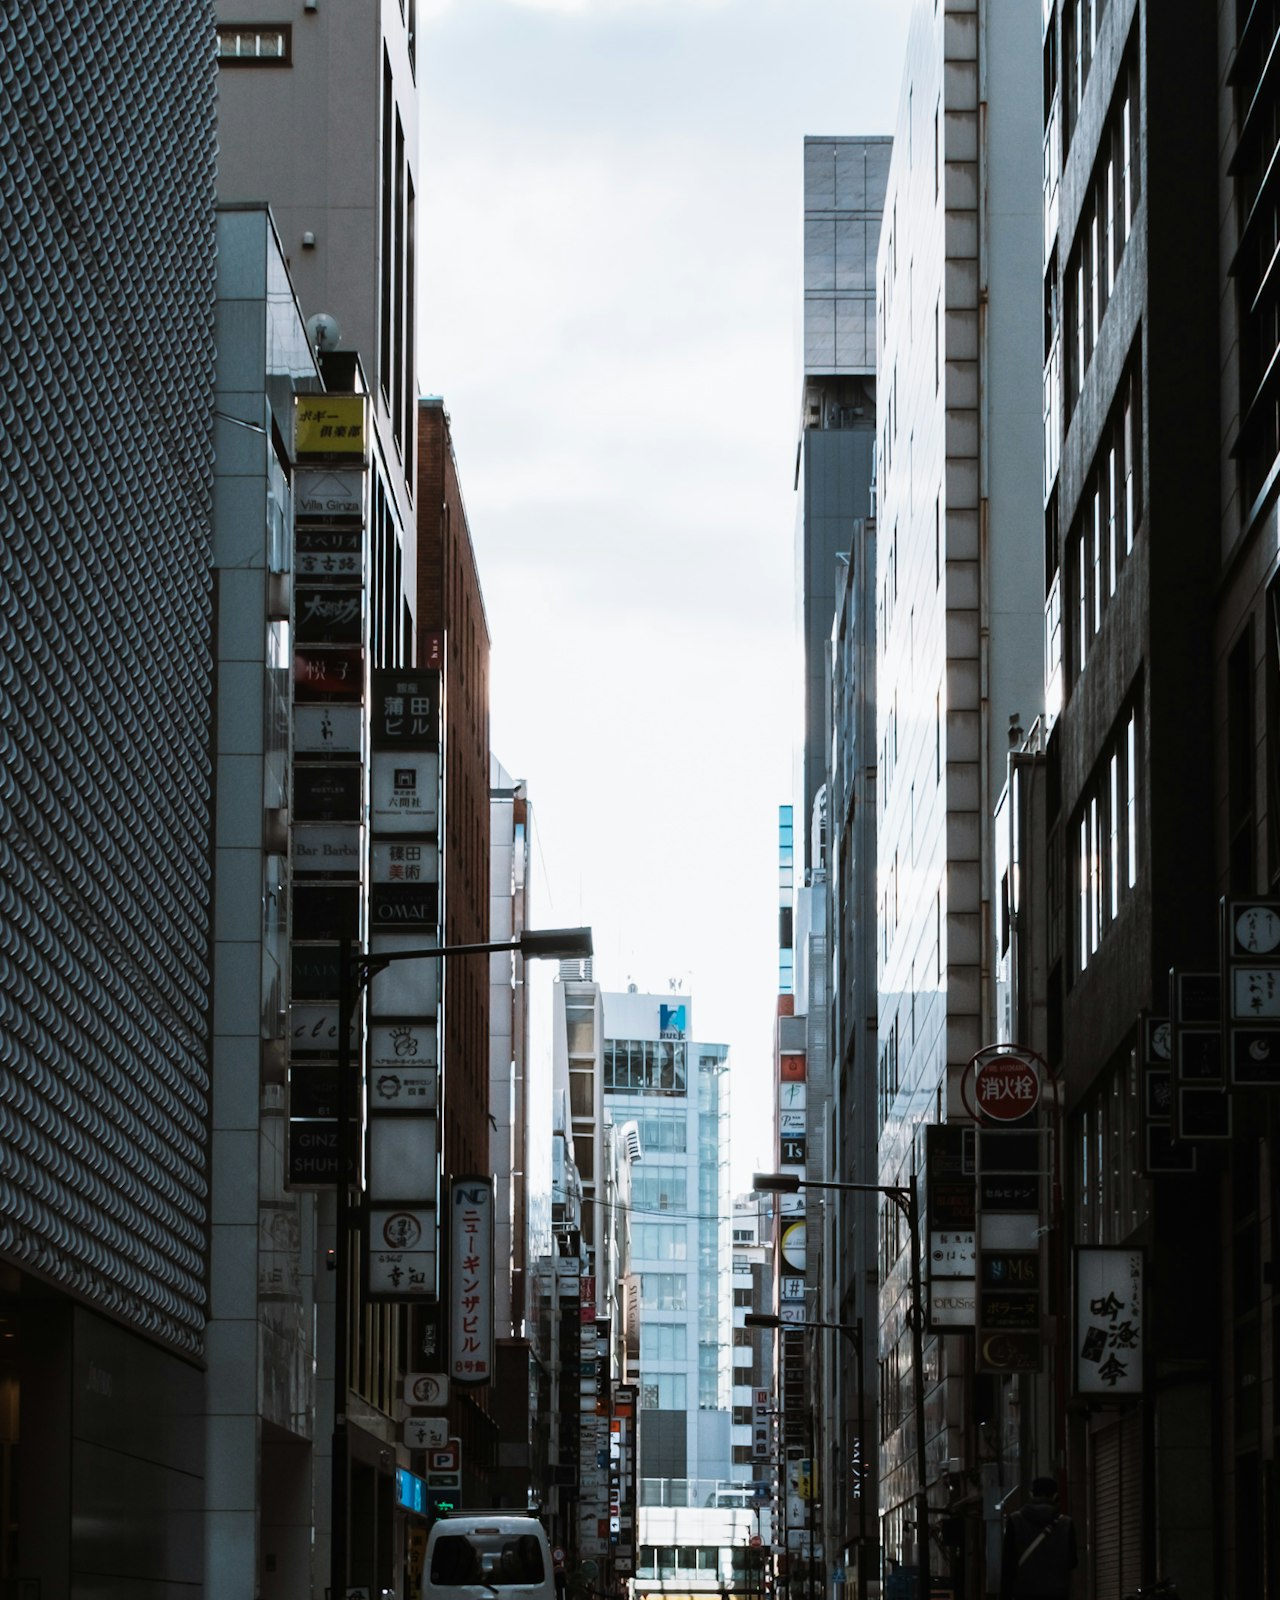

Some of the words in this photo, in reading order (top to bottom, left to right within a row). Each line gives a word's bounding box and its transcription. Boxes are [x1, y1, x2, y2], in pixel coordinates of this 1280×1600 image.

[301, 499, 323, 511] Villa
[326, 499, 359, 512] Ginza
[306, 660, 349, 681] 悦子
[384, 697, 430, 716] 蒲田
[385, 718, 430, 736] ビル
[296, 843, 318, 857] Bar
[389, 864, 421, 880] 美術
[981, 1075, 1034, 1101] 消火栓
[299, 1134, 338, 1148] GINZ
[462, 1211, 480, 1353] ニューギンザビル
[455, 1360, 486, 1373] 8号館
[437, 1455, 450, 1466] P
